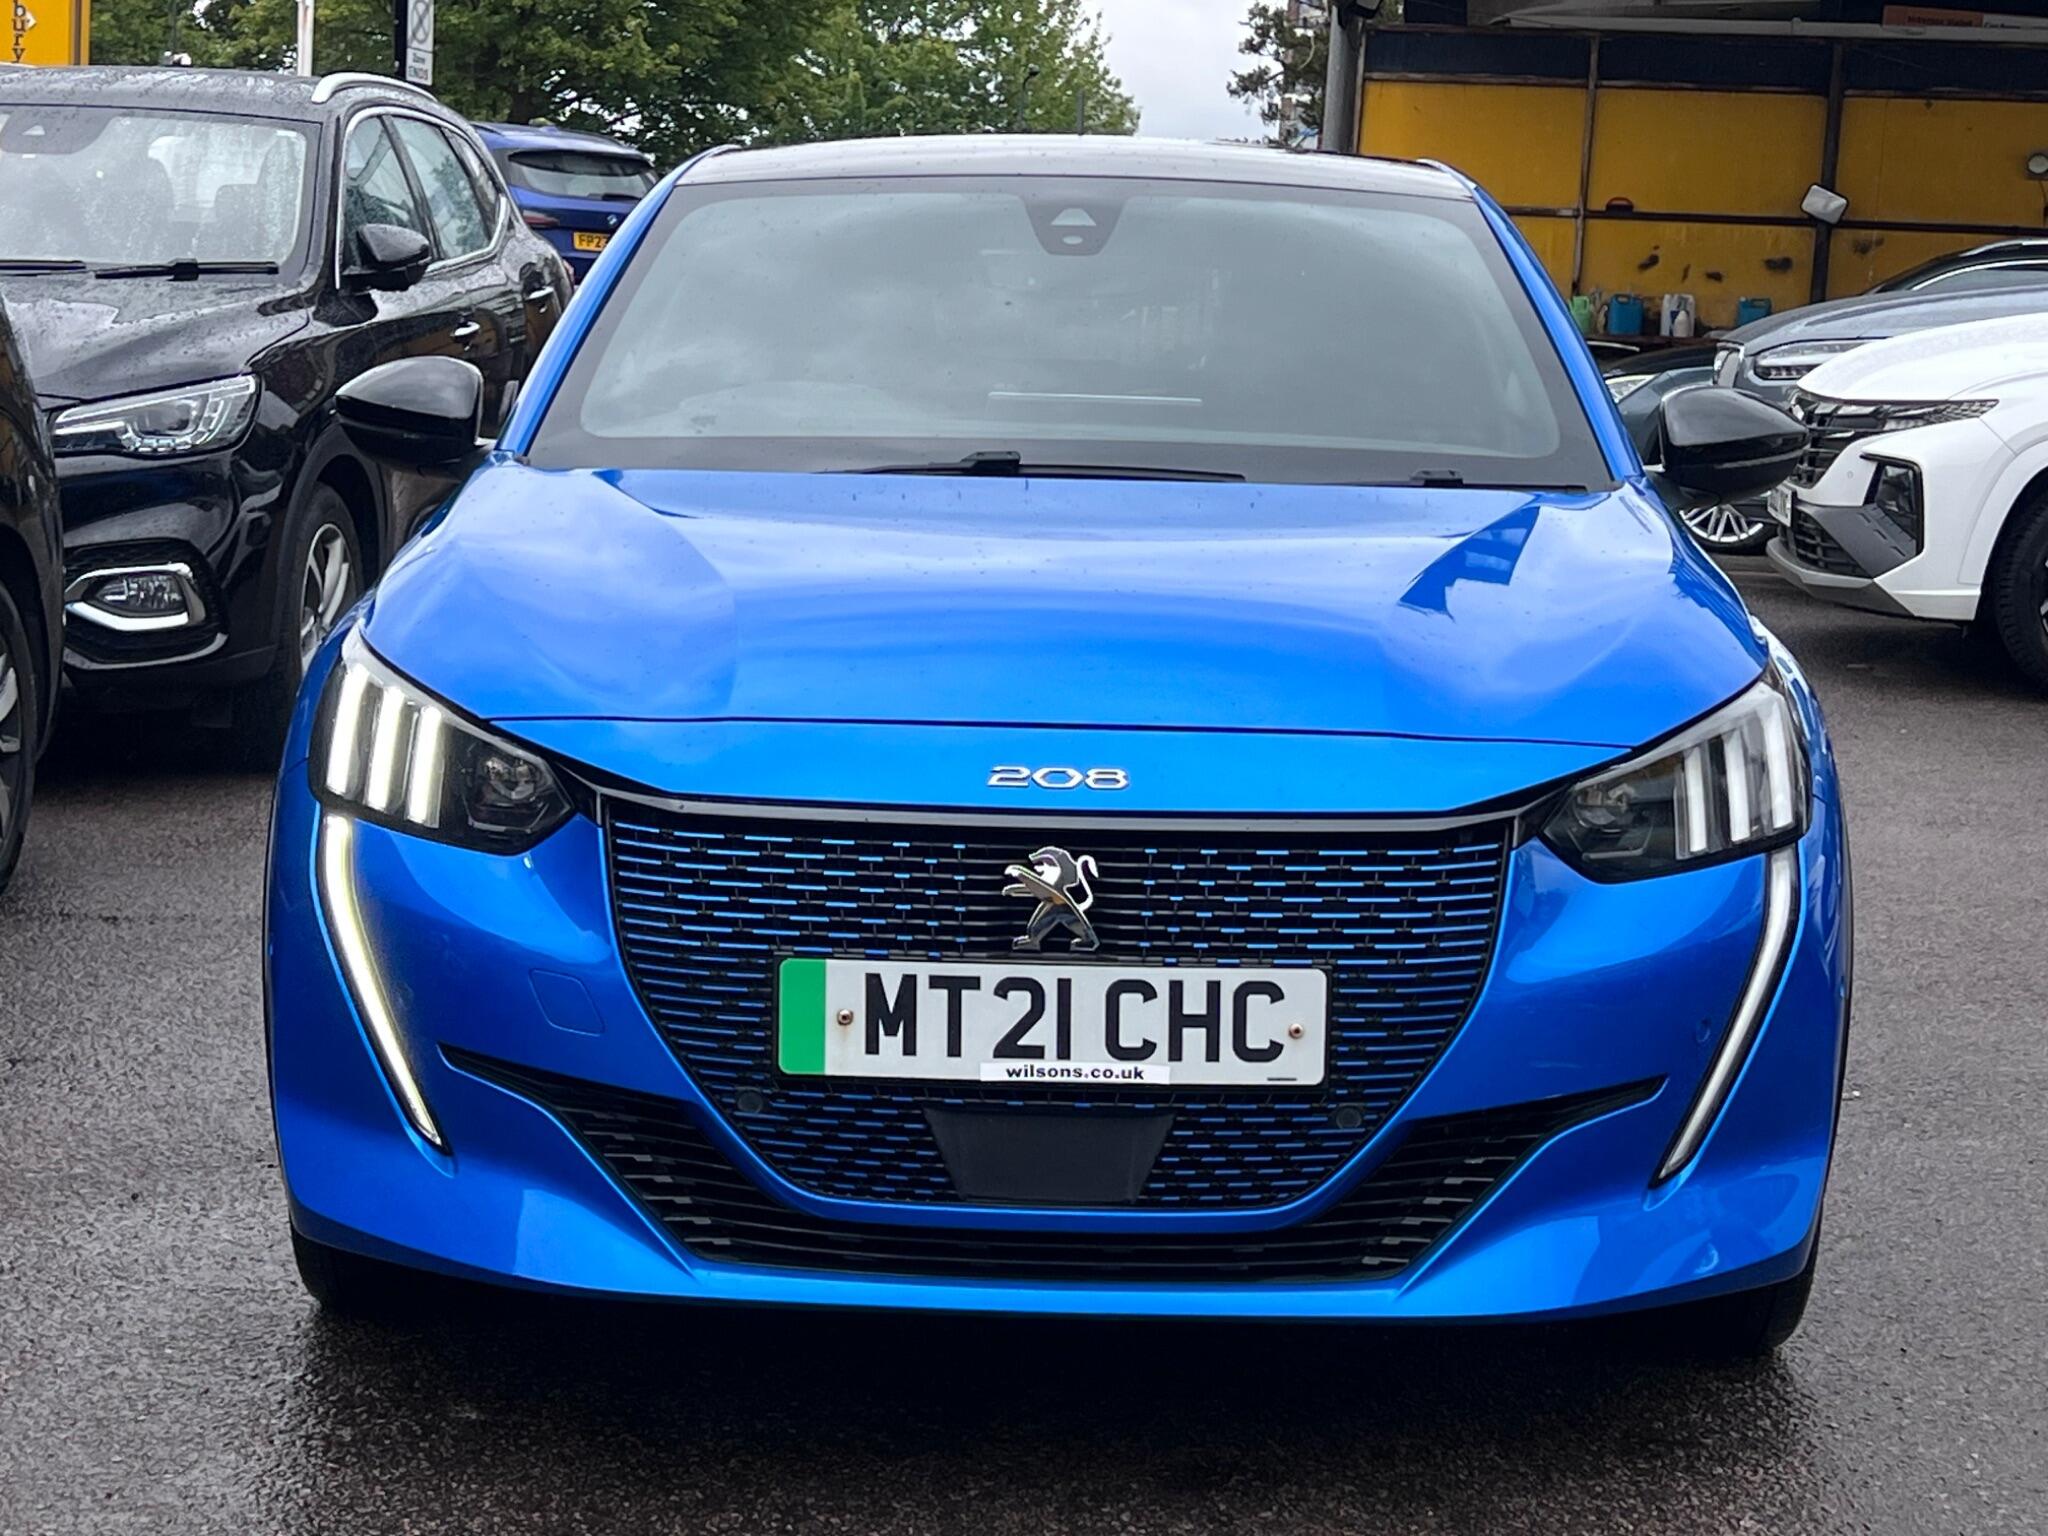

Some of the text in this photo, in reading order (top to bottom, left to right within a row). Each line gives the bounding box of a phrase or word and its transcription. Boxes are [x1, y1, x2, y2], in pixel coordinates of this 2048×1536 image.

[987, 765, 1129, 790] 208
[865, 973, 1285, 1063] MT21 CHC
[1006, 1065, 1145, 1080] wilsons.co.uk
